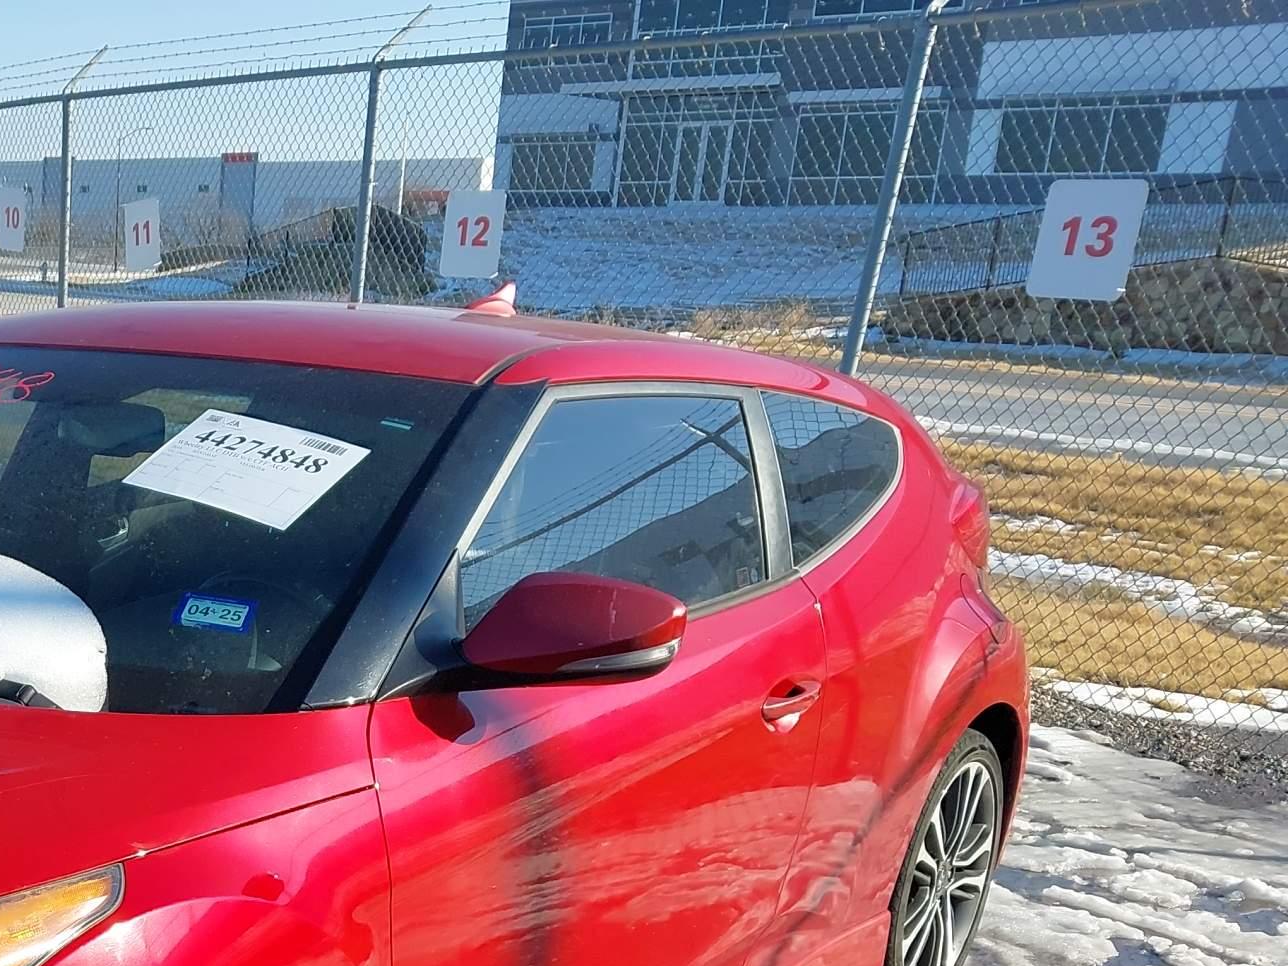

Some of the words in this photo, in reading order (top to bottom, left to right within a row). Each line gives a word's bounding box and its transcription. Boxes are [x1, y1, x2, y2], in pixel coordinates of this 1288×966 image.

[4, 206, 20, 229] 10
[456, 216, 490, 247] 12
[132, 220, 151, 246] 11
[1062, 216, 1118, 257] 13
[194, 430, 329, 474] 44274848
[187, 604, 210, 617] 04
[219, 608, 243, 622] 25
